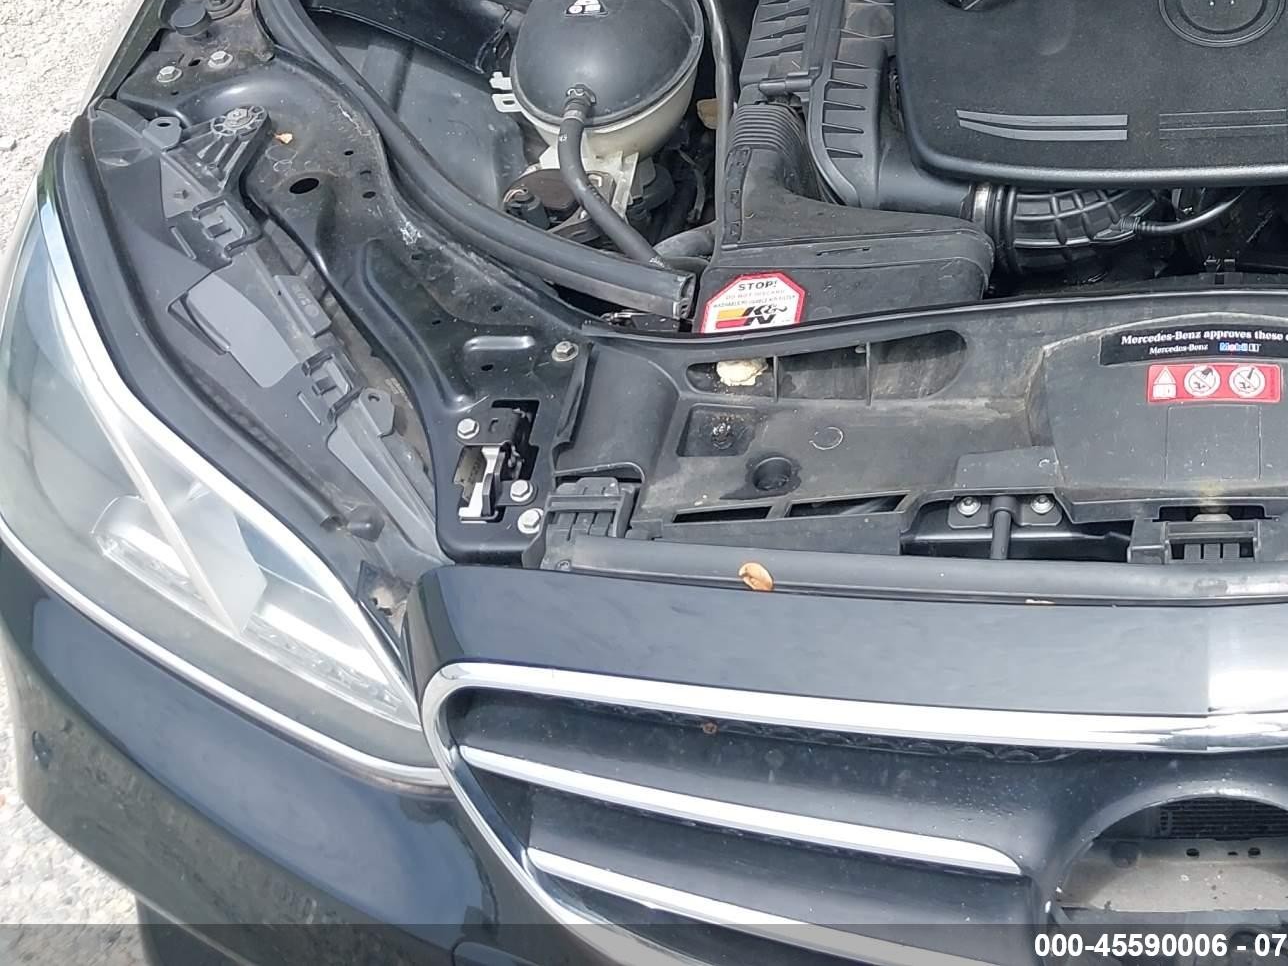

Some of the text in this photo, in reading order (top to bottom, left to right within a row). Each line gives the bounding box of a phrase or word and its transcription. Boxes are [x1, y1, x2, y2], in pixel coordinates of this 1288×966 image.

[738, 280, 778, 291] STOP!
[1121, 331, 1201, 345] Mercedes-Benz
[1204, 330, 1252, 341] approves
[1254, 330, 1283, 341] these
[1149, 344, 1209, 355] Mercedes-Benz
